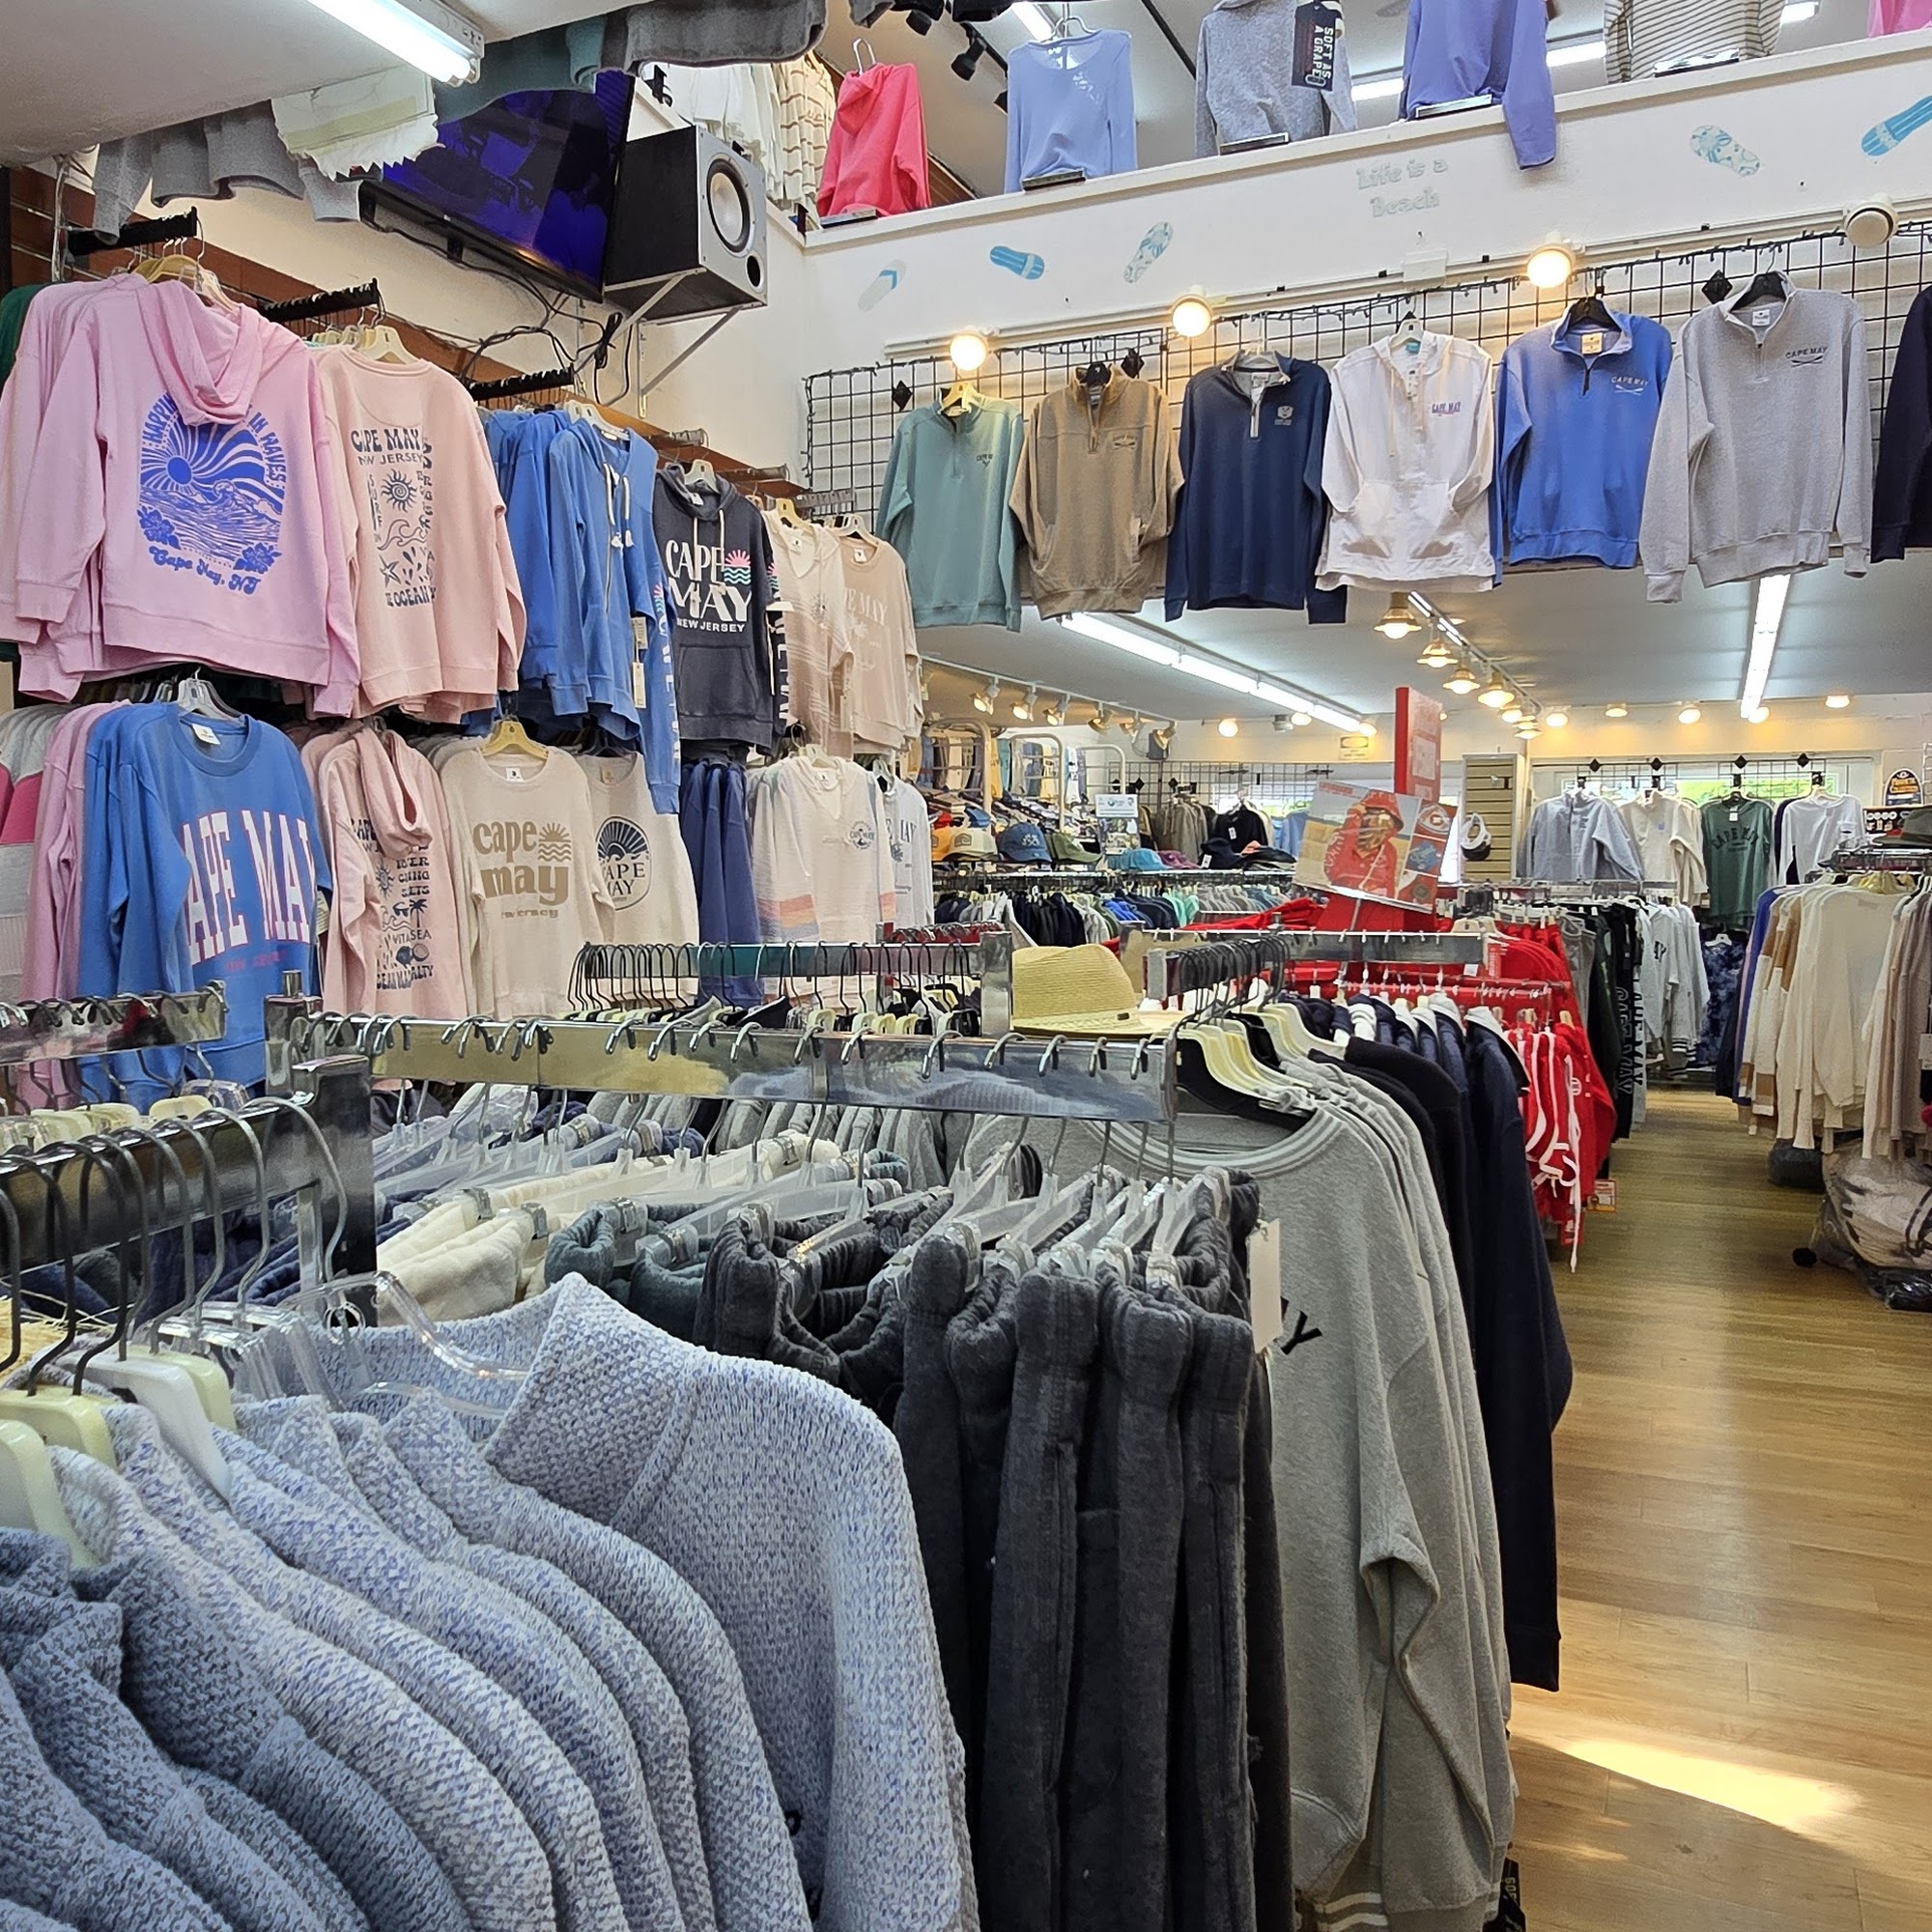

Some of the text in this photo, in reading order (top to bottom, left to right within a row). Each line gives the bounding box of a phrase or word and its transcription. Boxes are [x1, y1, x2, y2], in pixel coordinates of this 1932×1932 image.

[1312, 37, 1323, 77] GRAPE
[1321, 26, 1333, 79] SOFT AS
[1356, 161, 1403, 189] Life
[1406, 158, 1426, 179] is
[1370, 185, 1439, 218] Beach
[1785, 350, 1808, 359] CAPE
[142, 392, 287, 484] HAPPIN IN WAVES
[384, 428, 422, 451] MAY
[380, 452, 423, 466] JERSEY
[149, 545, 193, 571] Cape
[228, 573, 262, 595] NJ
[668, 577, 753, 623] MAY
[676, 618, 745, 633] NEW JERSEY
[472, 821, 537, 864] cape
[182, 810, 249, 965] APE
[480, 866, 569, 906] may
[411, 928, 432, 941] SEA
[411, 965, 433, 982] ALTY
